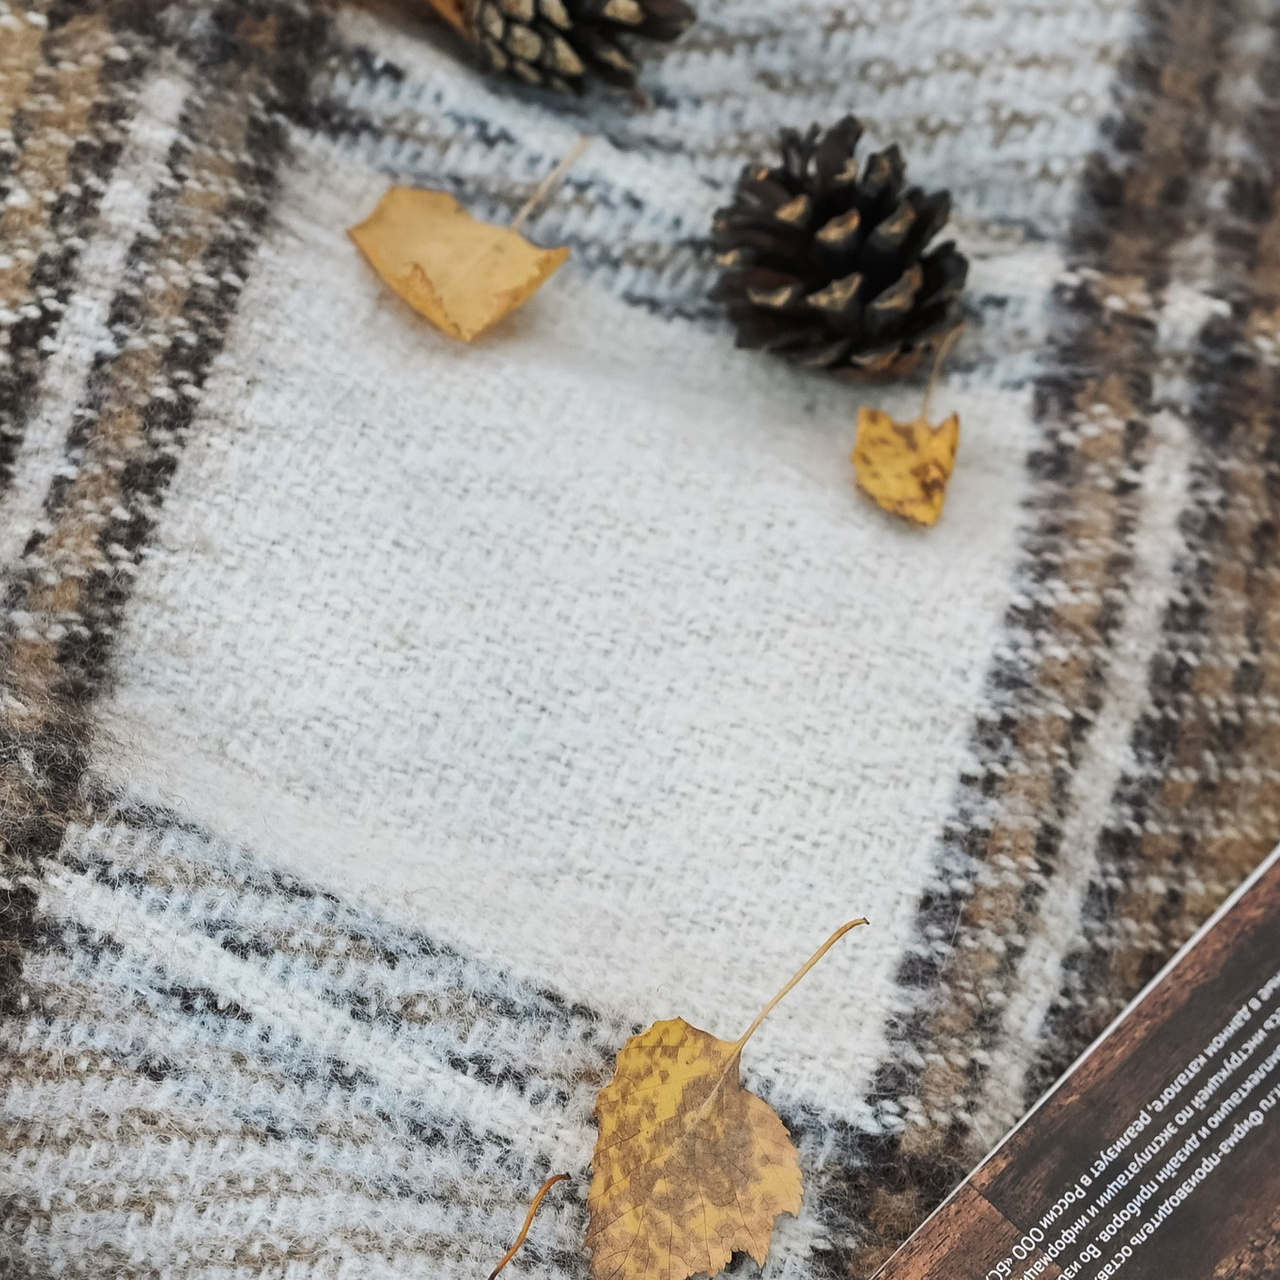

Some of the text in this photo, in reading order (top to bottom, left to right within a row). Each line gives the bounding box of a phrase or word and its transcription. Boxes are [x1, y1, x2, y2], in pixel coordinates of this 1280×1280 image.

[1247, 996, 1262, 1011] в
[1202, 1003, 1252, 1058] данном
[1145, 1053, 1208, 1112] каталоге,
[1189, 1027, 1268, 1110] инструкцией
[1173, 1104, 1195, 1125] по
[1196, 1124, 1211, 1139] и
[1088, 1109, 1152, 1178] реализует
[1094, 1121, 1178, 1208] эксплуатации
[1154, 1132, 1201, 1184] дизайн
[1078, 1173, 1093, 1187] в
[1128, 1109, 1264, 1246] Фирма-производитель
[1038, 1183, 1087, 1229] России
[1085, 1203, 1099, 1218] и
[1094, 1179, 1159, 1243] приборов.
[1011, 1226, 1045, 1260] ООО
[1078, 1242, 1102, 1263] Во
